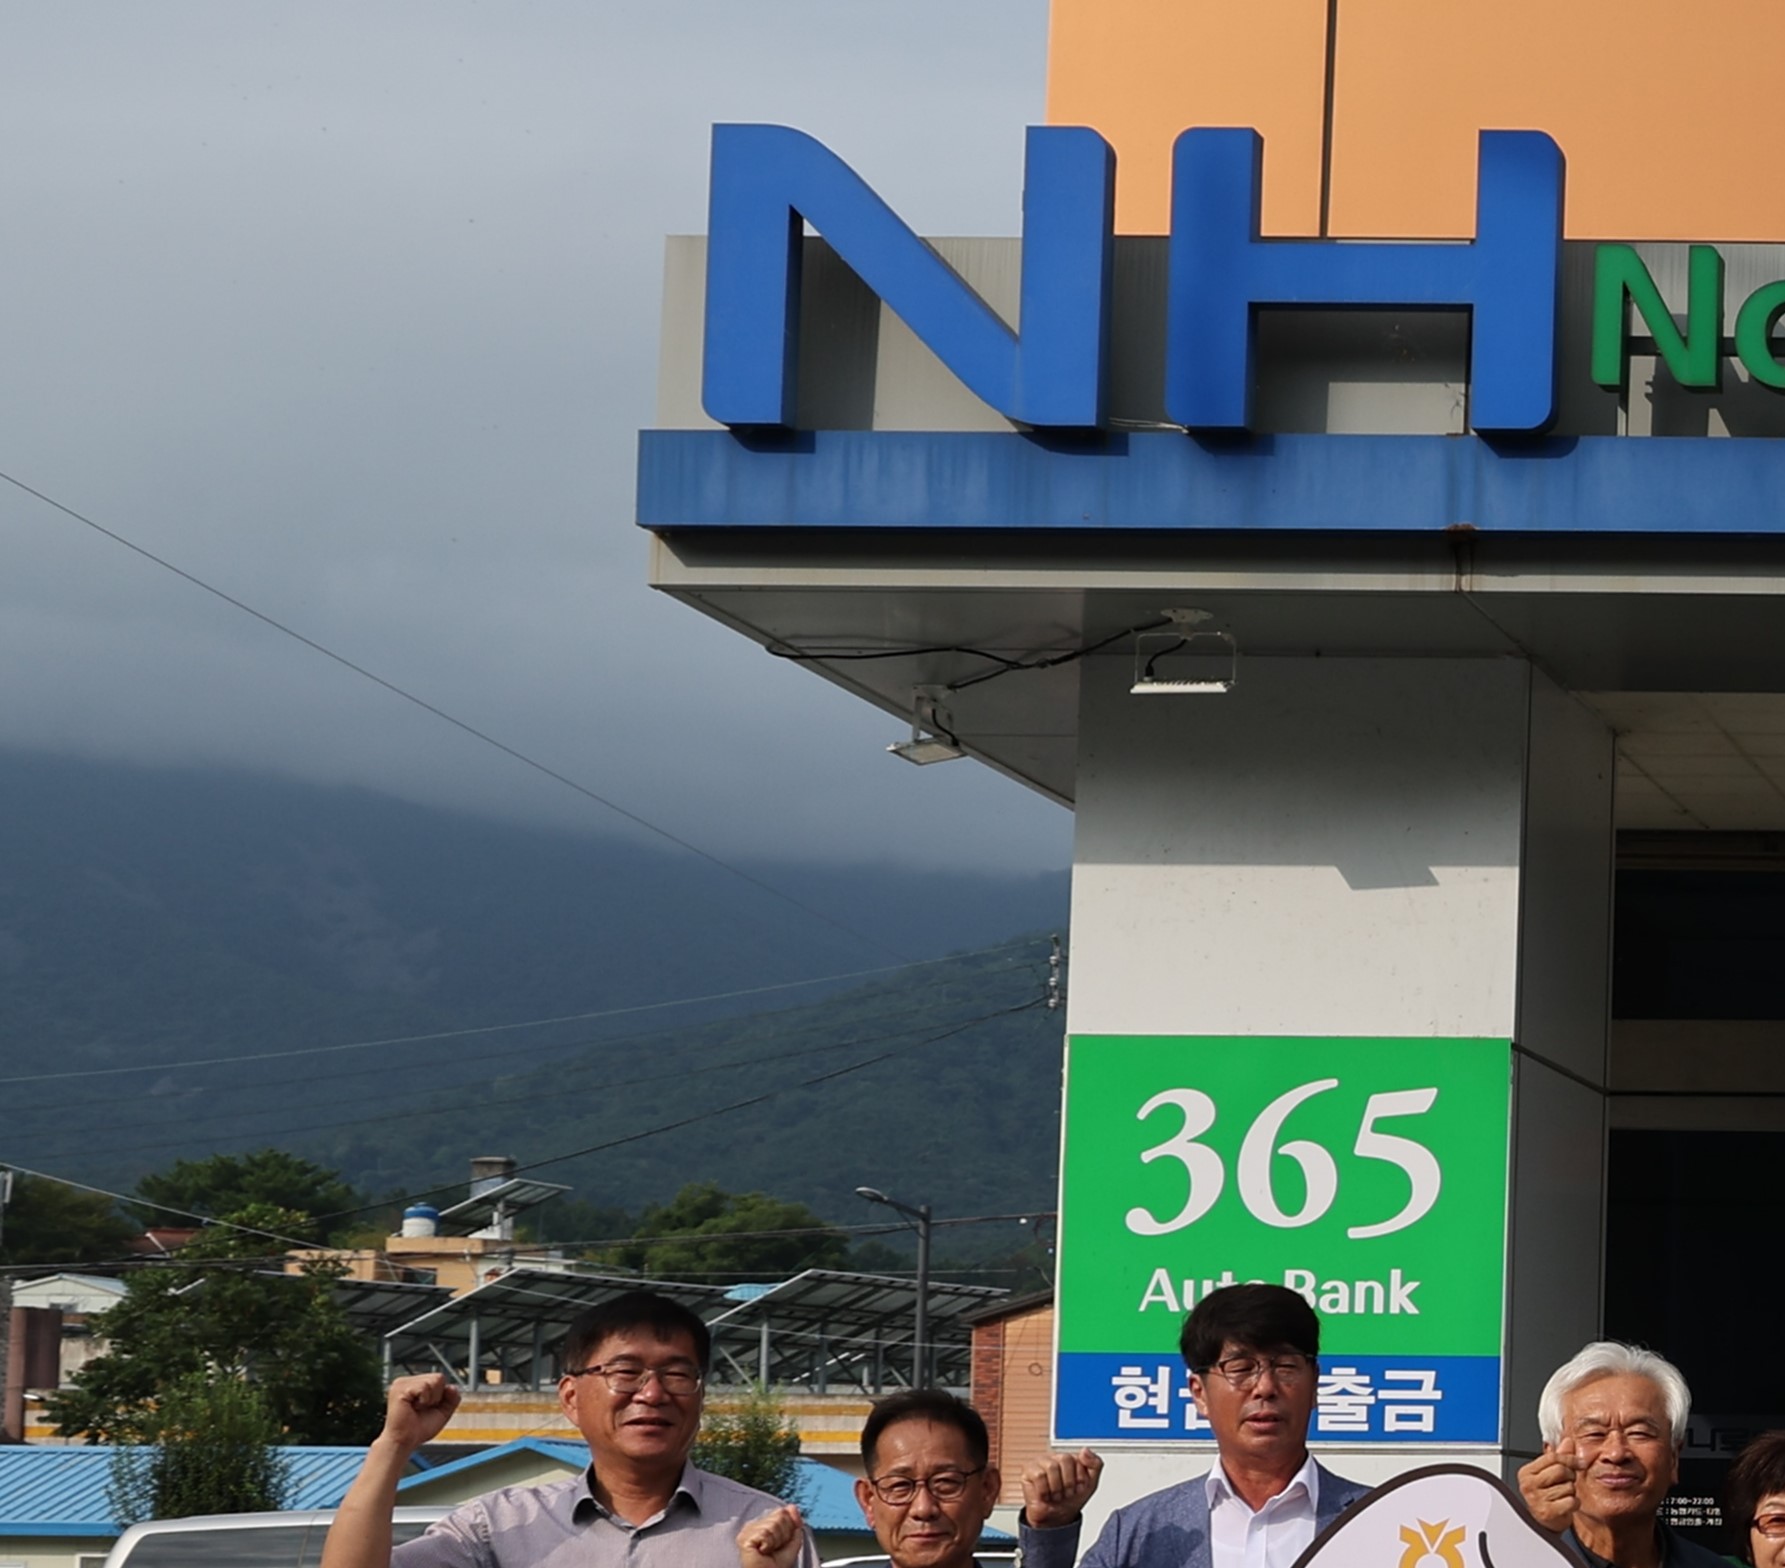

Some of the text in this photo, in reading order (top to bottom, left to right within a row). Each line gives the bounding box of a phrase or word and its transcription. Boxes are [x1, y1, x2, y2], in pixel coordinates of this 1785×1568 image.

[700, 119, 1566, 432] NH
[1124, 1077, 1442, 1240] 365
[1285, 1268, 1421, 1315] Bank
